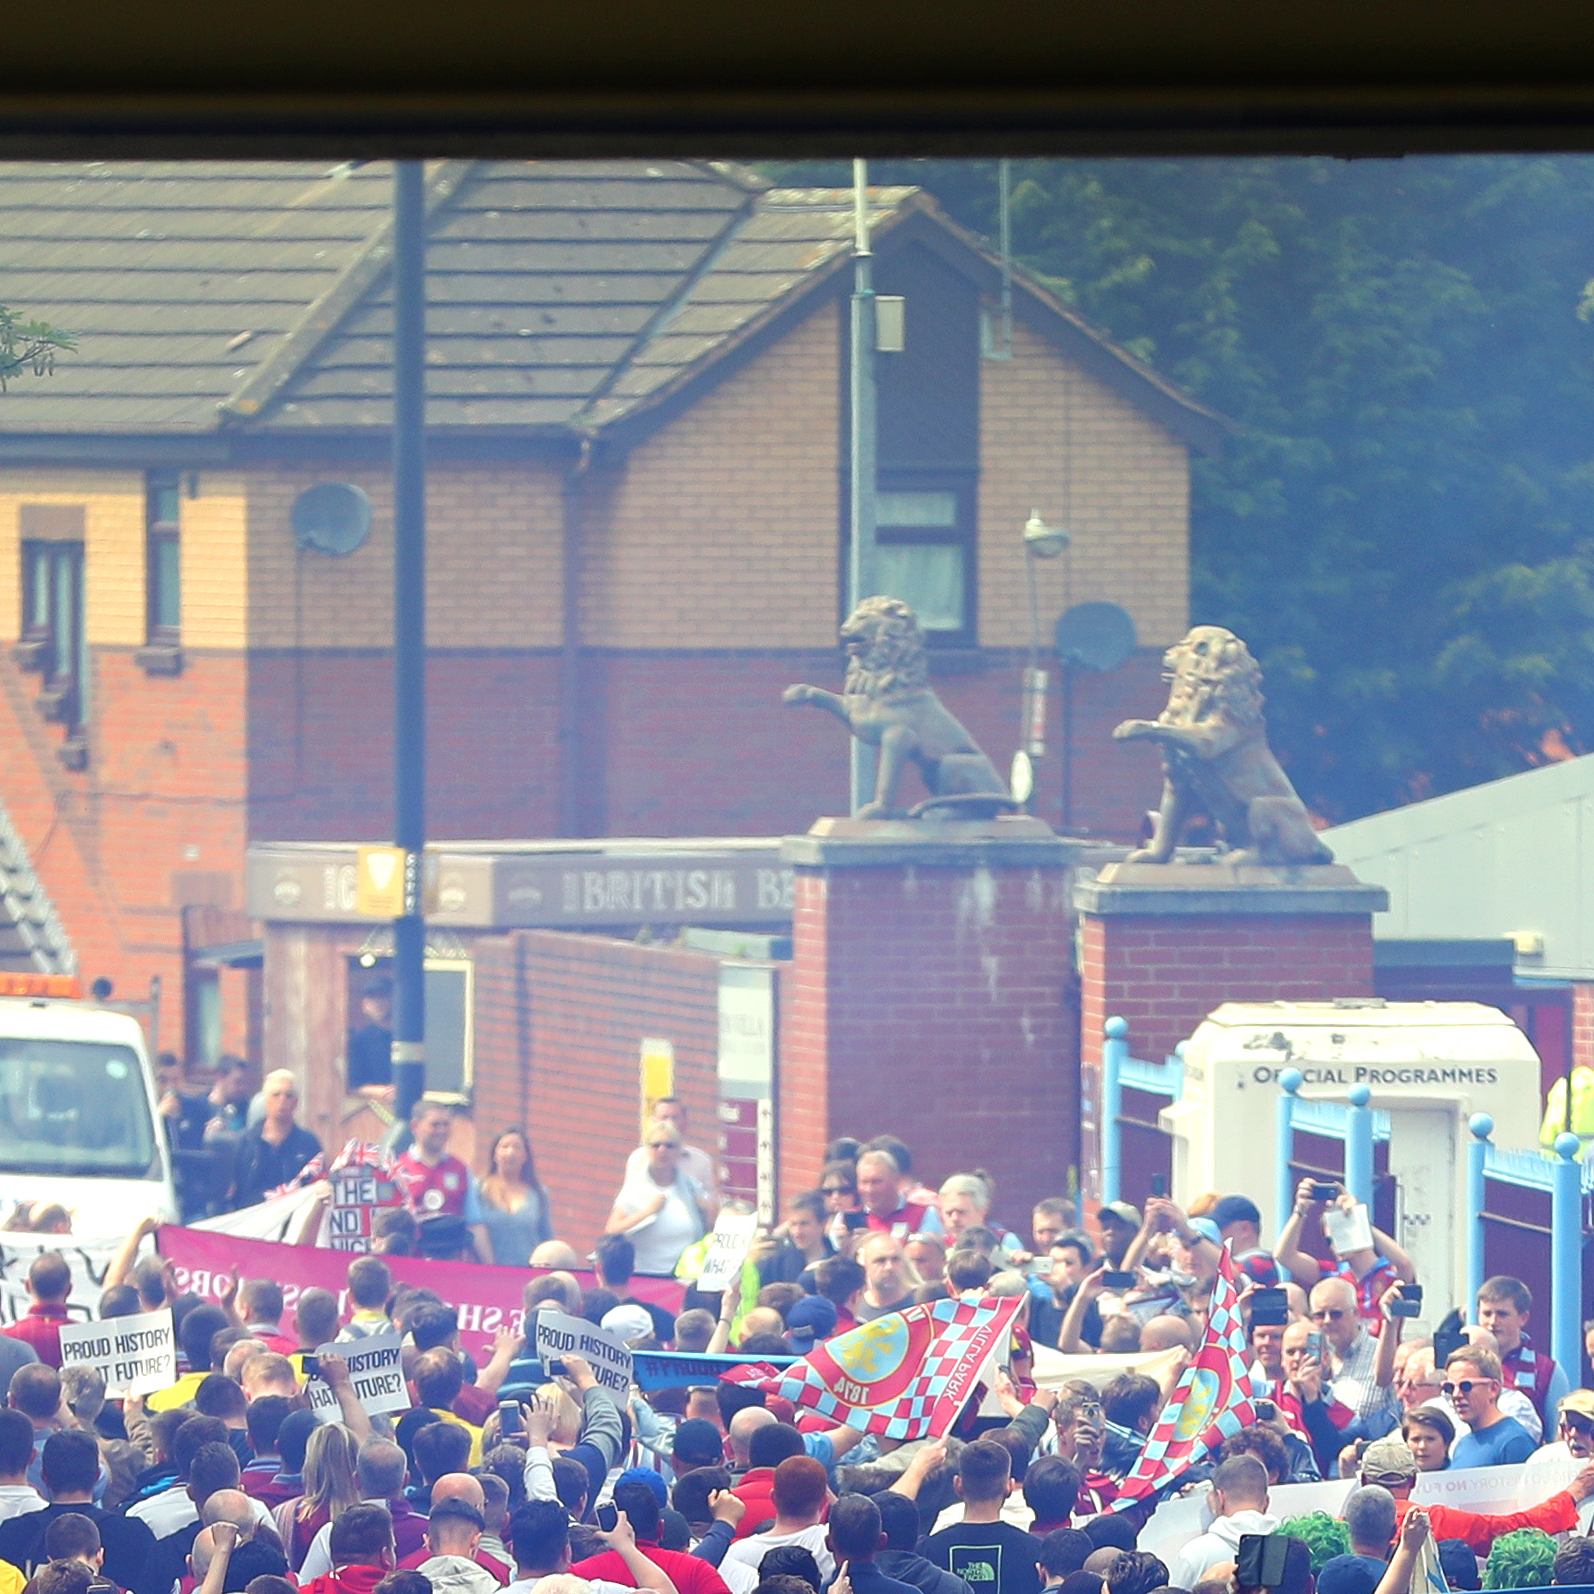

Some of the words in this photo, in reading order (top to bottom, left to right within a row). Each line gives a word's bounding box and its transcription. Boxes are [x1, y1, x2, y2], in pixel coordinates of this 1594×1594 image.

[1355, 1066, 1498, 1084] PROGRAMMES
[63, 1339, 111, 1362] PROUD
[115, 1327, 171, 1353] HISTORY
[537, 1323, 576, 1351] PROUD
[579, 1334, 632, 1369] HISTORY
[115, 1354, 172, 1383] FUTURE?
